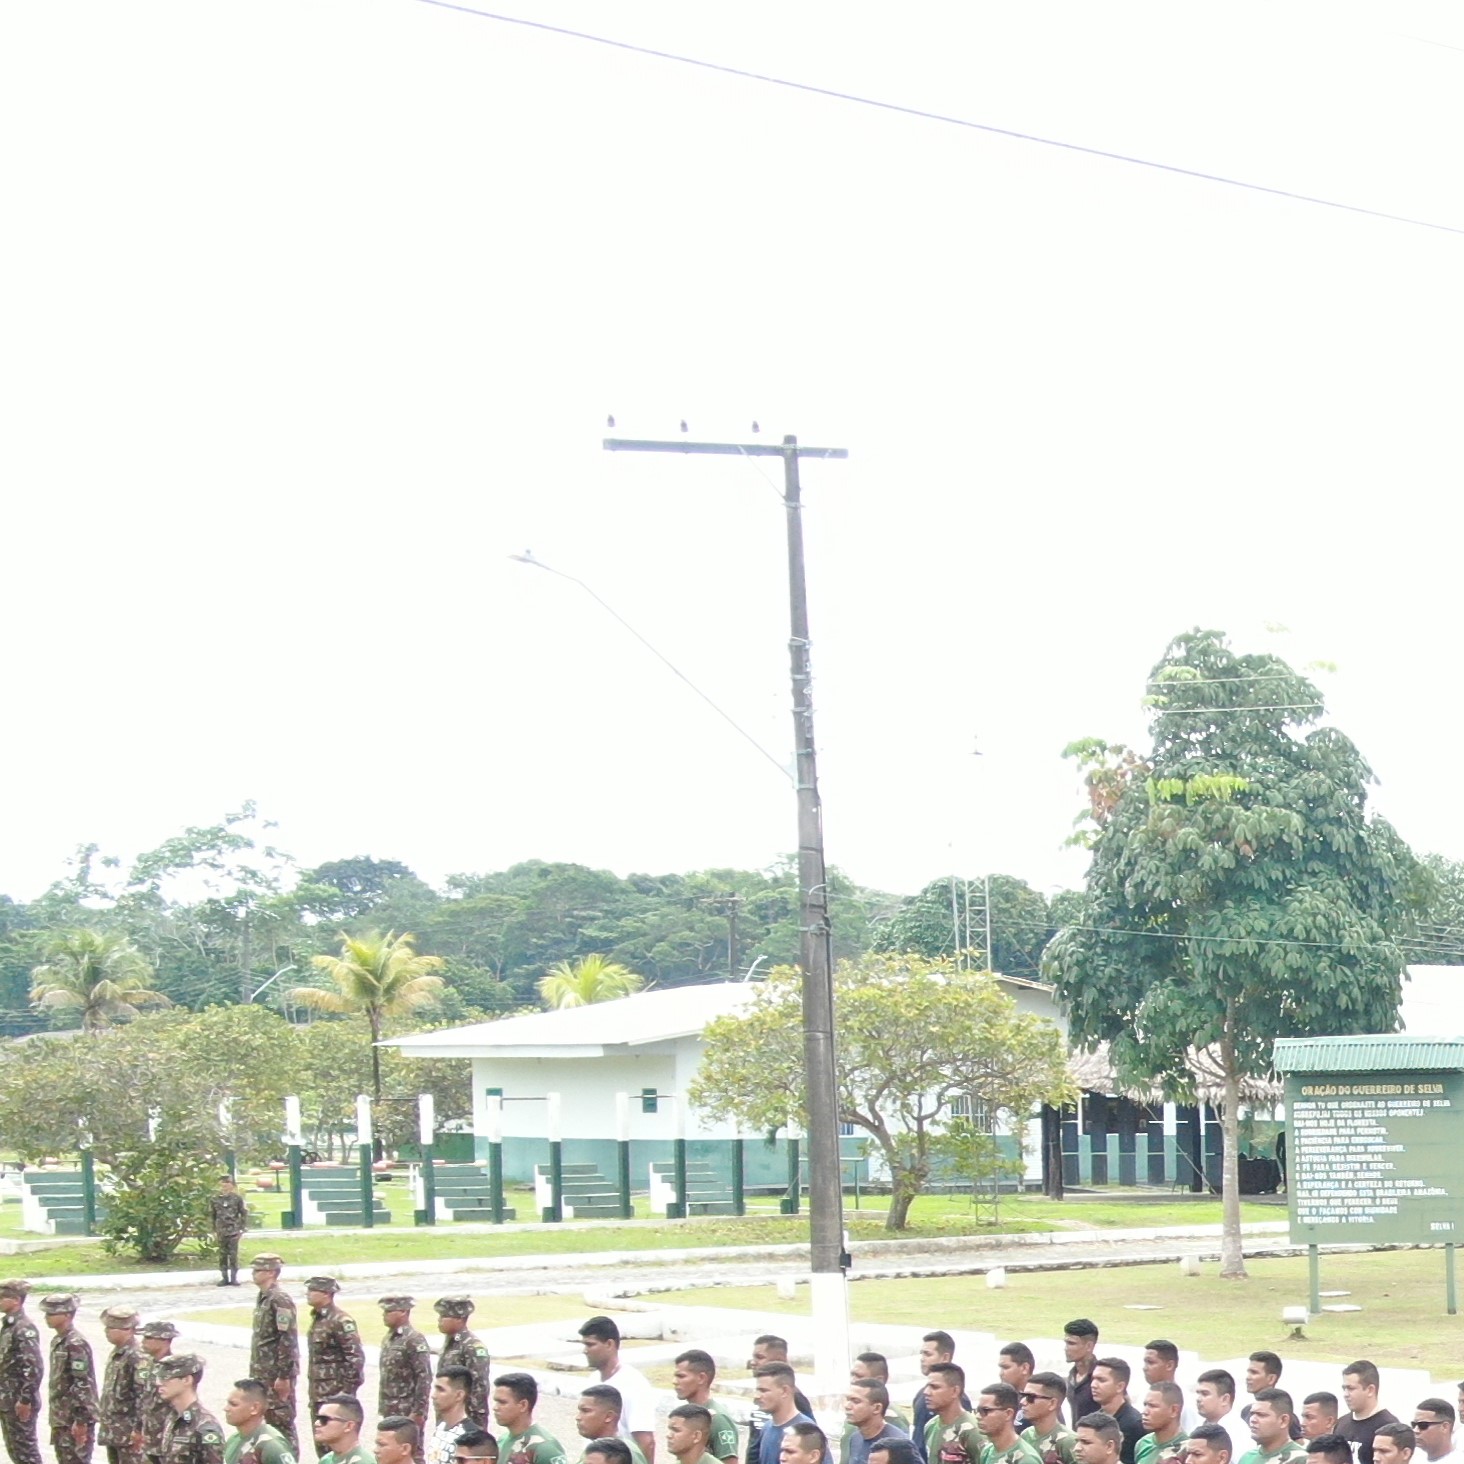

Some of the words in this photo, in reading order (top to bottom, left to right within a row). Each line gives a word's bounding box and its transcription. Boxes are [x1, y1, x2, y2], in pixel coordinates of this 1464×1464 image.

[1301, 1084, 1336, 1097] ORAÇÃO
[1338, 1085, 1351, 1096] DO
[1352, 1084, 1402, 1095] GUERREIRO
[1404, 1084, 1415, 1094] DE
[1417, 1083, 1443, 1094] SELVA
